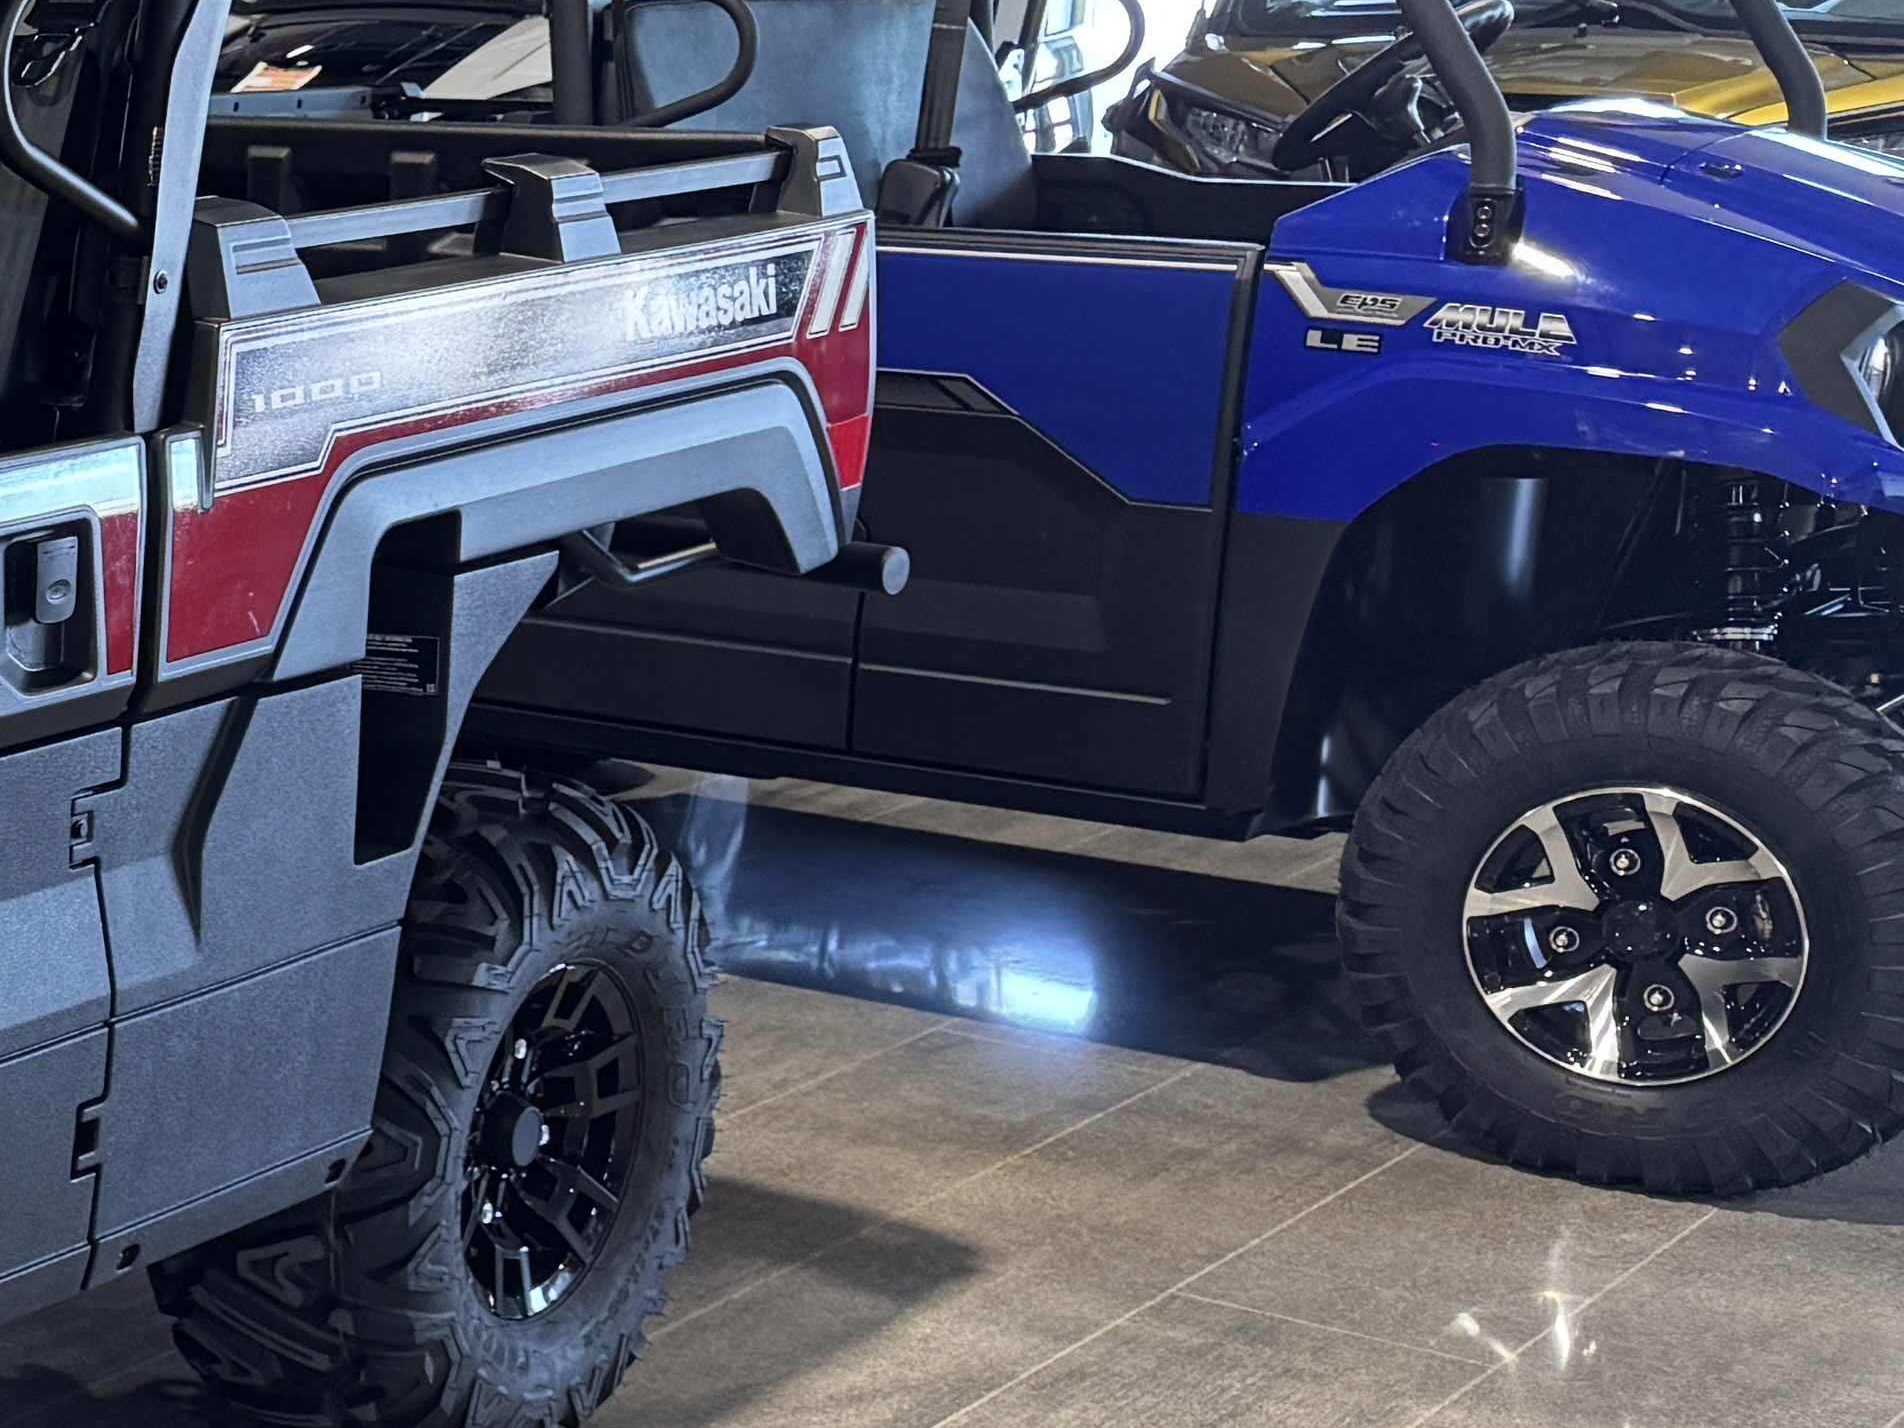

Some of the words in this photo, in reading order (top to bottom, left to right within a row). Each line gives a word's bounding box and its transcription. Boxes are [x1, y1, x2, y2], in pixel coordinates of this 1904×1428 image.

[622, 262, 779, 341] Kawasaki
[1305, 329, 1380, 353] LE
[250, 371, 382, 414] 1000
